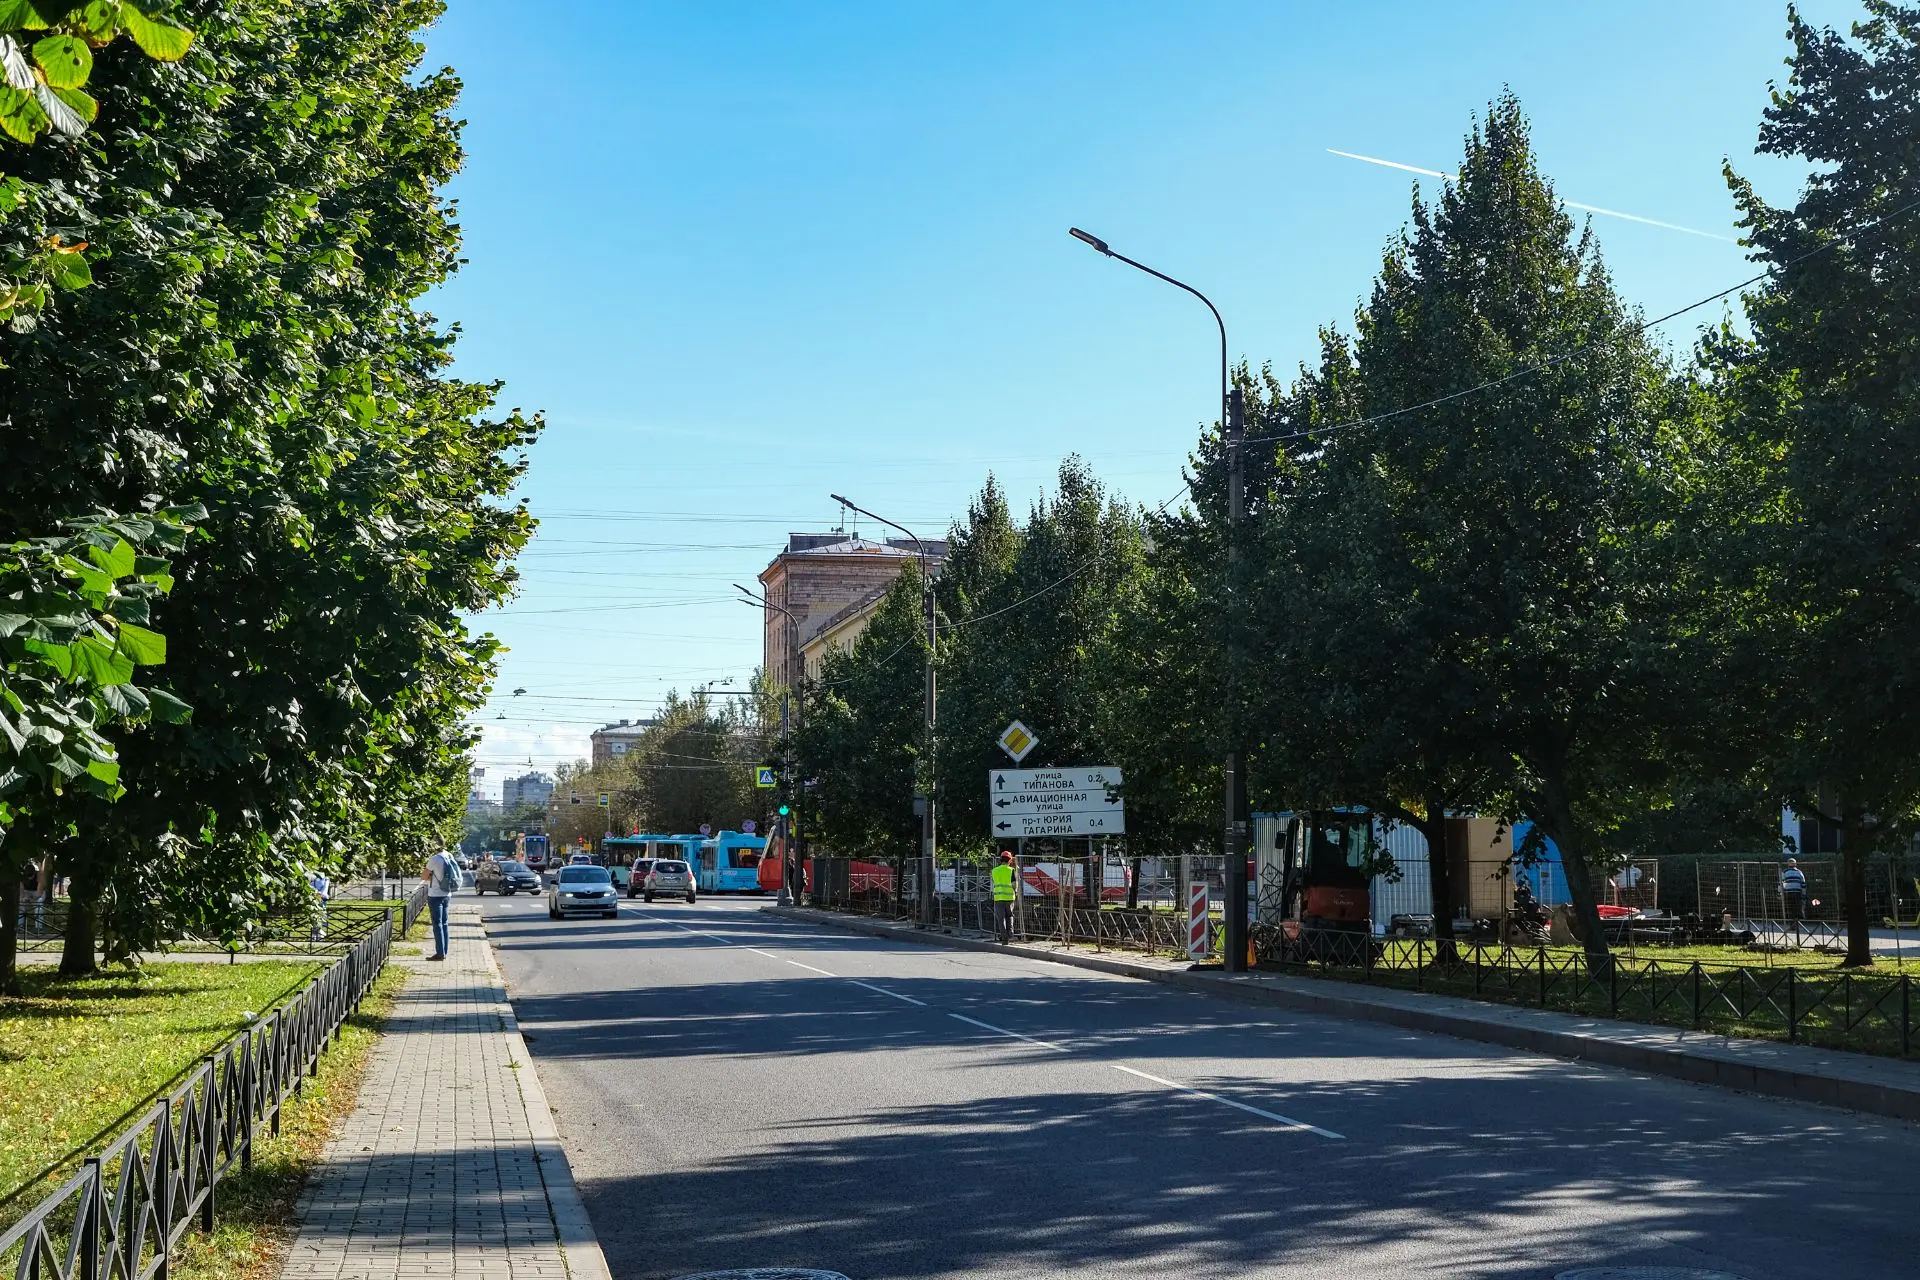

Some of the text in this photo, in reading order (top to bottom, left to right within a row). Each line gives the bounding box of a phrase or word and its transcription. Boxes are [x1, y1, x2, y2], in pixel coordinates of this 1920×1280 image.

[1035, 772, 1062, 781] улица
[1023, 781, 1075, 790] ТИПАНОВА
[1012, 793, 1087, 803] АВИАЦИОННАЯ
[1036, 803, 1063, 812] улица
[1022, 815, 1072, 826] пр-т ЮРИЯ
[1089, 818, 1103, 827] 0.4
[1024, 825, 1074, 834] ГАГАРИНА
